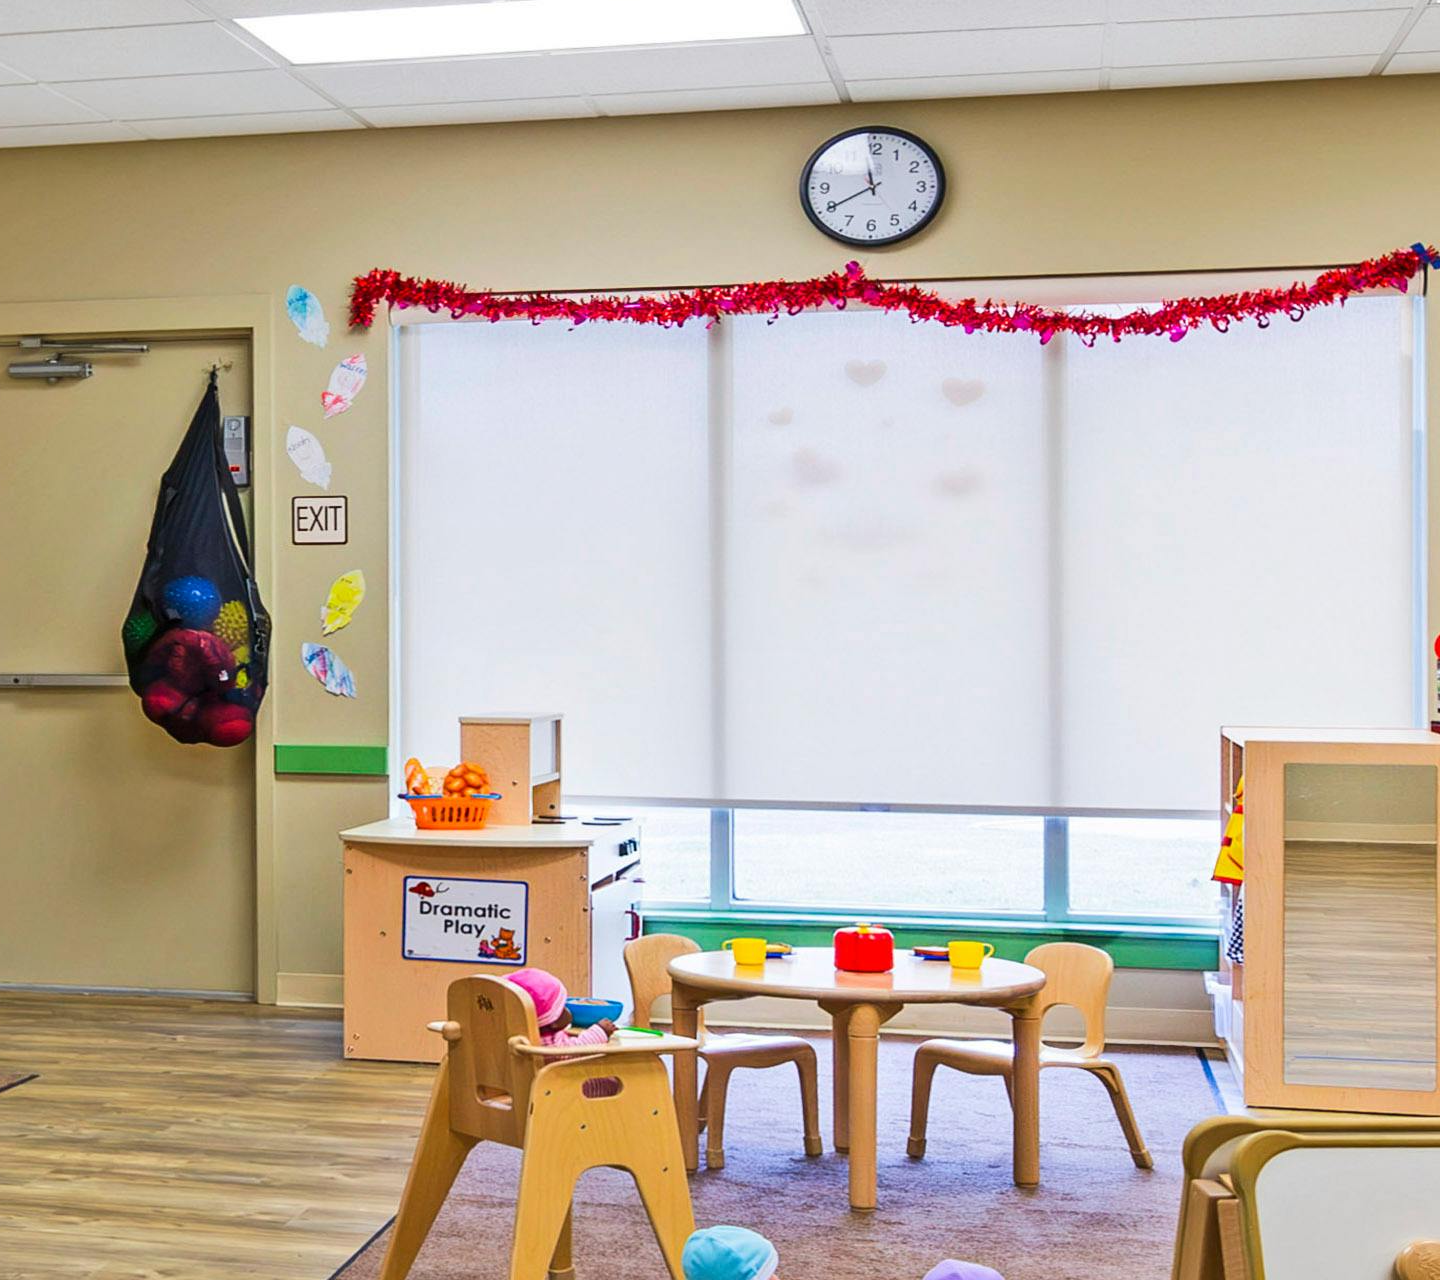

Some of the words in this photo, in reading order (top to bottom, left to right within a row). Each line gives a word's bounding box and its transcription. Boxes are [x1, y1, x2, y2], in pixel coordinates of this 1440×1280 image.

[908, 160, 920, 173] 2
[819, 182, 830, 194] 9
[915, 180, 927, 193] 3
[908, 200, 918, 212] 4
[845, 215, 855, 227] 7
[866, 219, 877, 232] 6
[889, 214, 900, 227] 5
[296, 505, 343, 532] EXIT
[419, 900, 512, 920] Dramatic
[443, 919, 486, 938] Play
